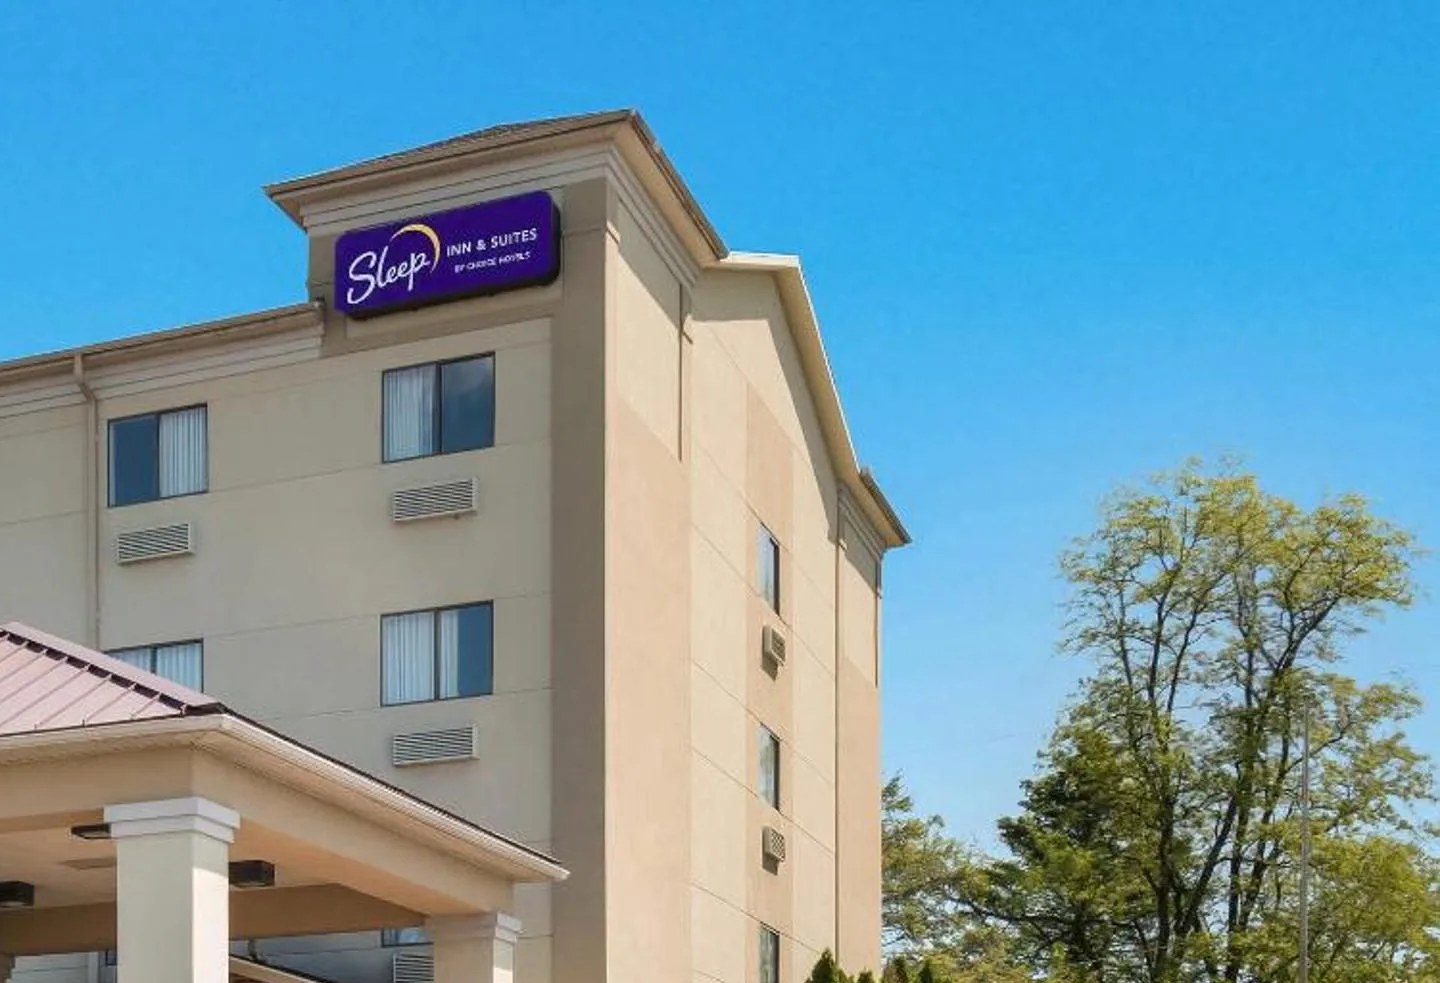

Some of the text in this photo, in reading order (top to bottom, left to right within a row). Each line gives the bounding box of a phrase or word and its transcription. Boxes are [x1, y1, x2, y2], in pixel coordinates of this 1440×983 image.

[446, 227, 537, 257] INN & SUITES
[346, 245, 431, 305] Sleep
